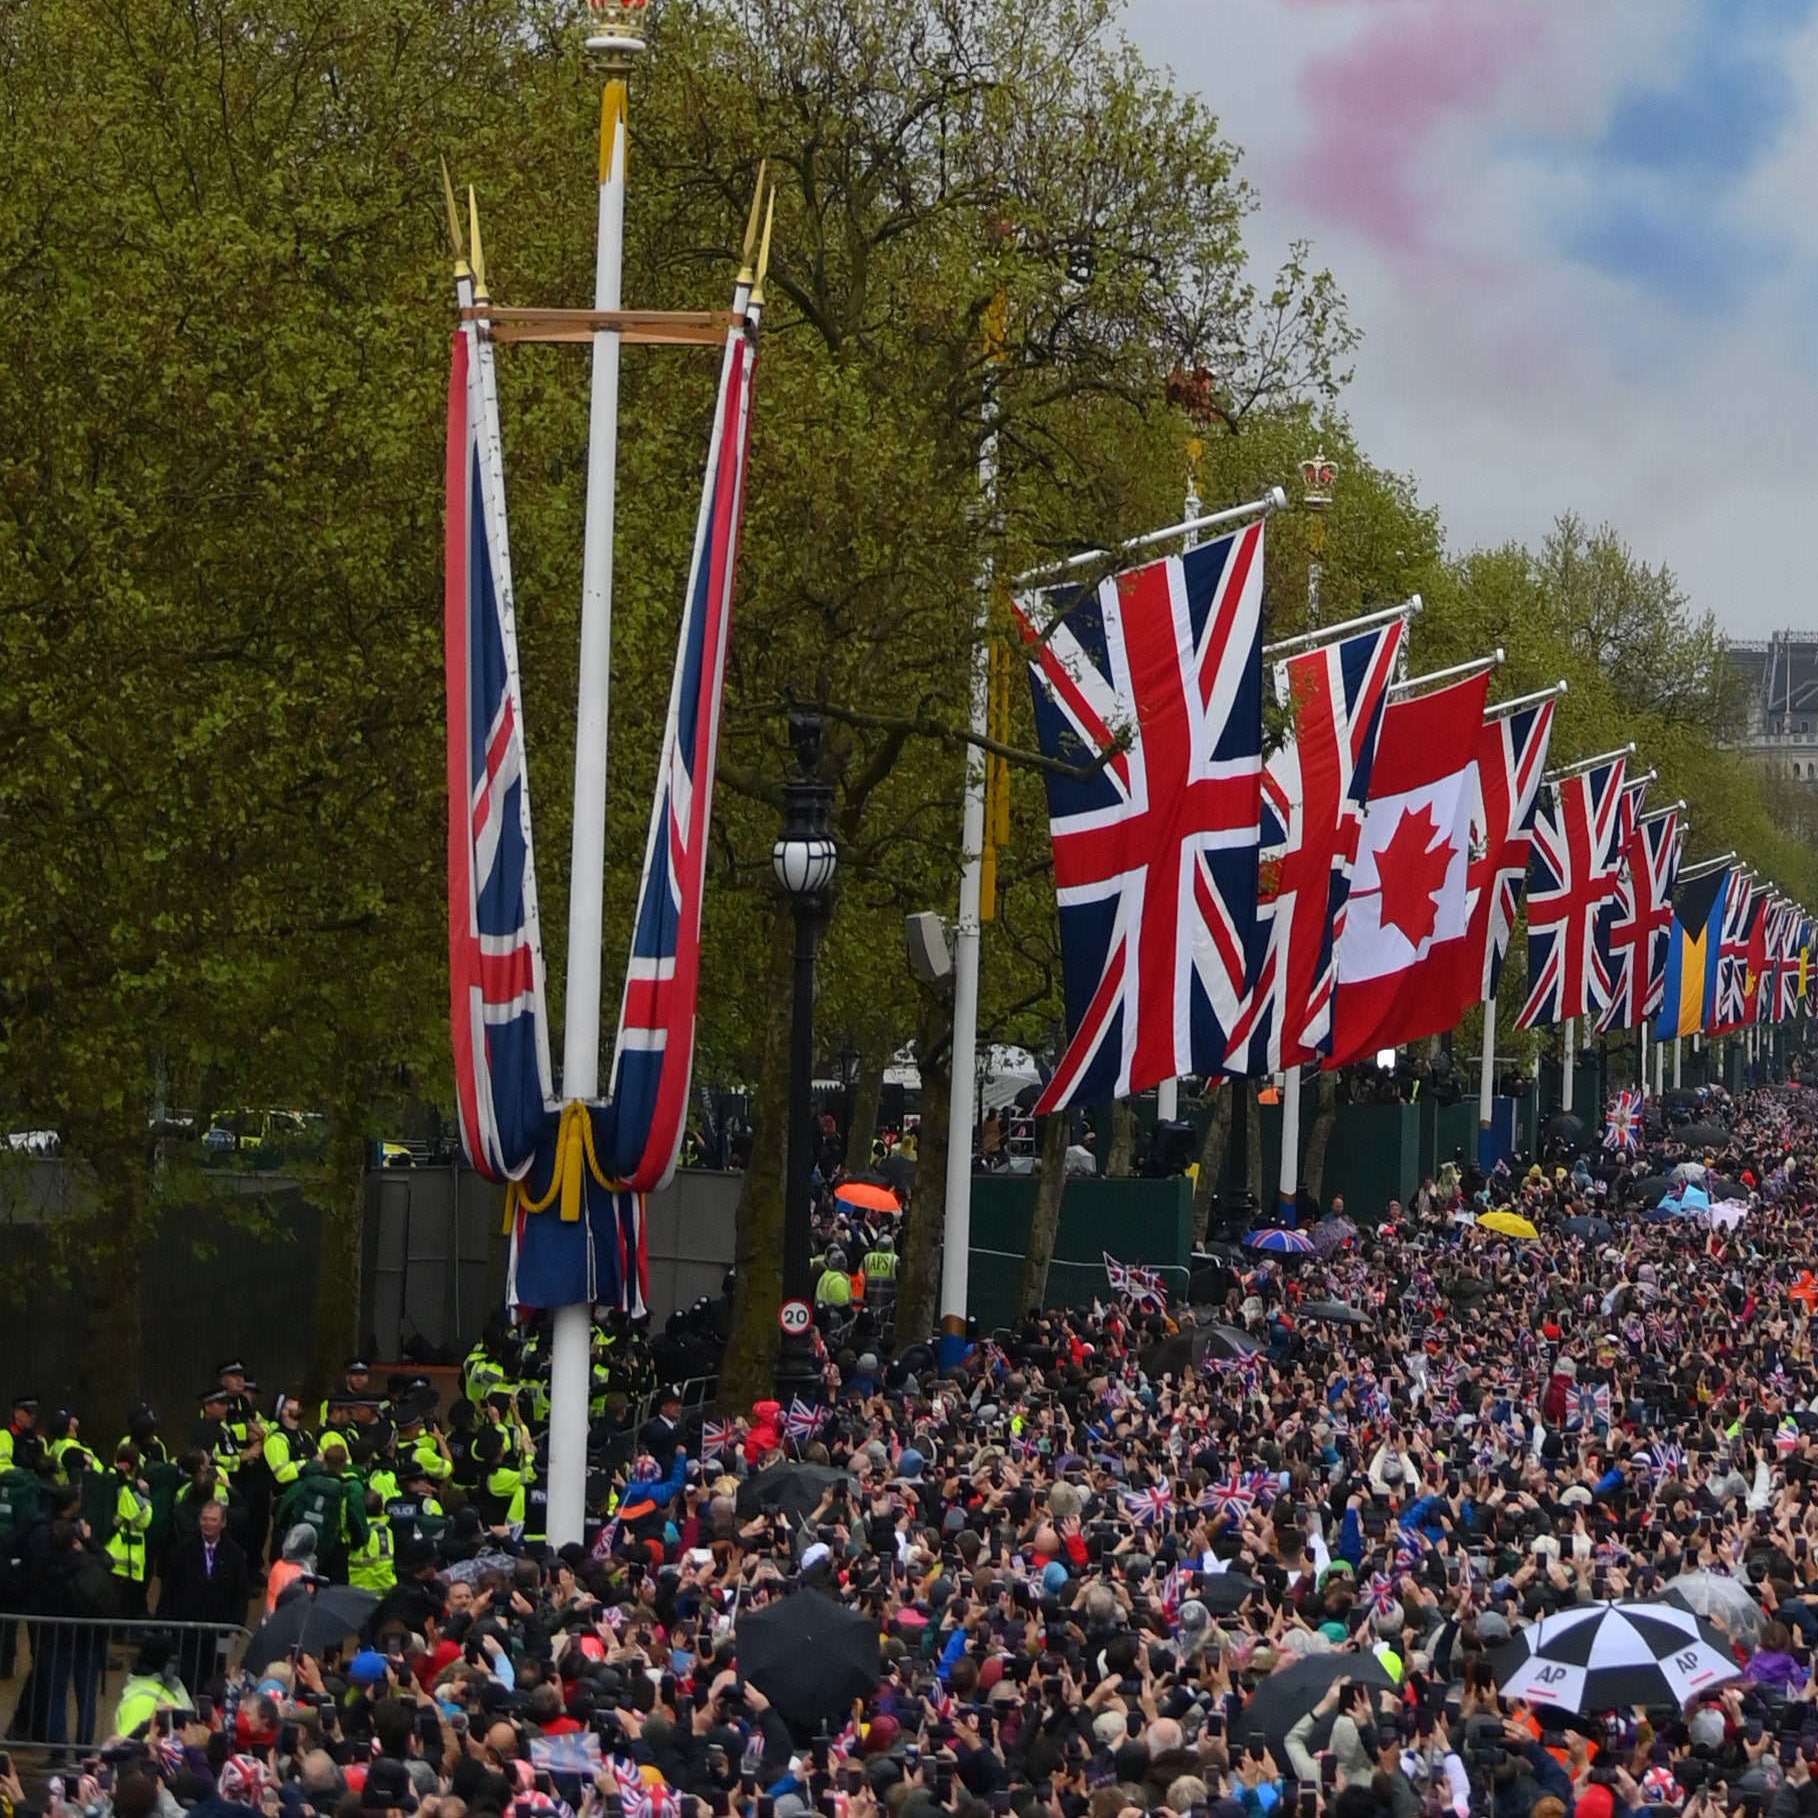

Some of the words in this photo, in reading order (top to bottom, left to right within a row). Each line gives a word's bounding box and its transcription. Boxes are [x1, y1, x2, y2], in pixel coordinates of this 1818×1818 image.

[784, 1310, 807, 1324] 20
[1675, 1651, 1698, 1674] AP
[1535, 1666, 1567, 1684] AP
